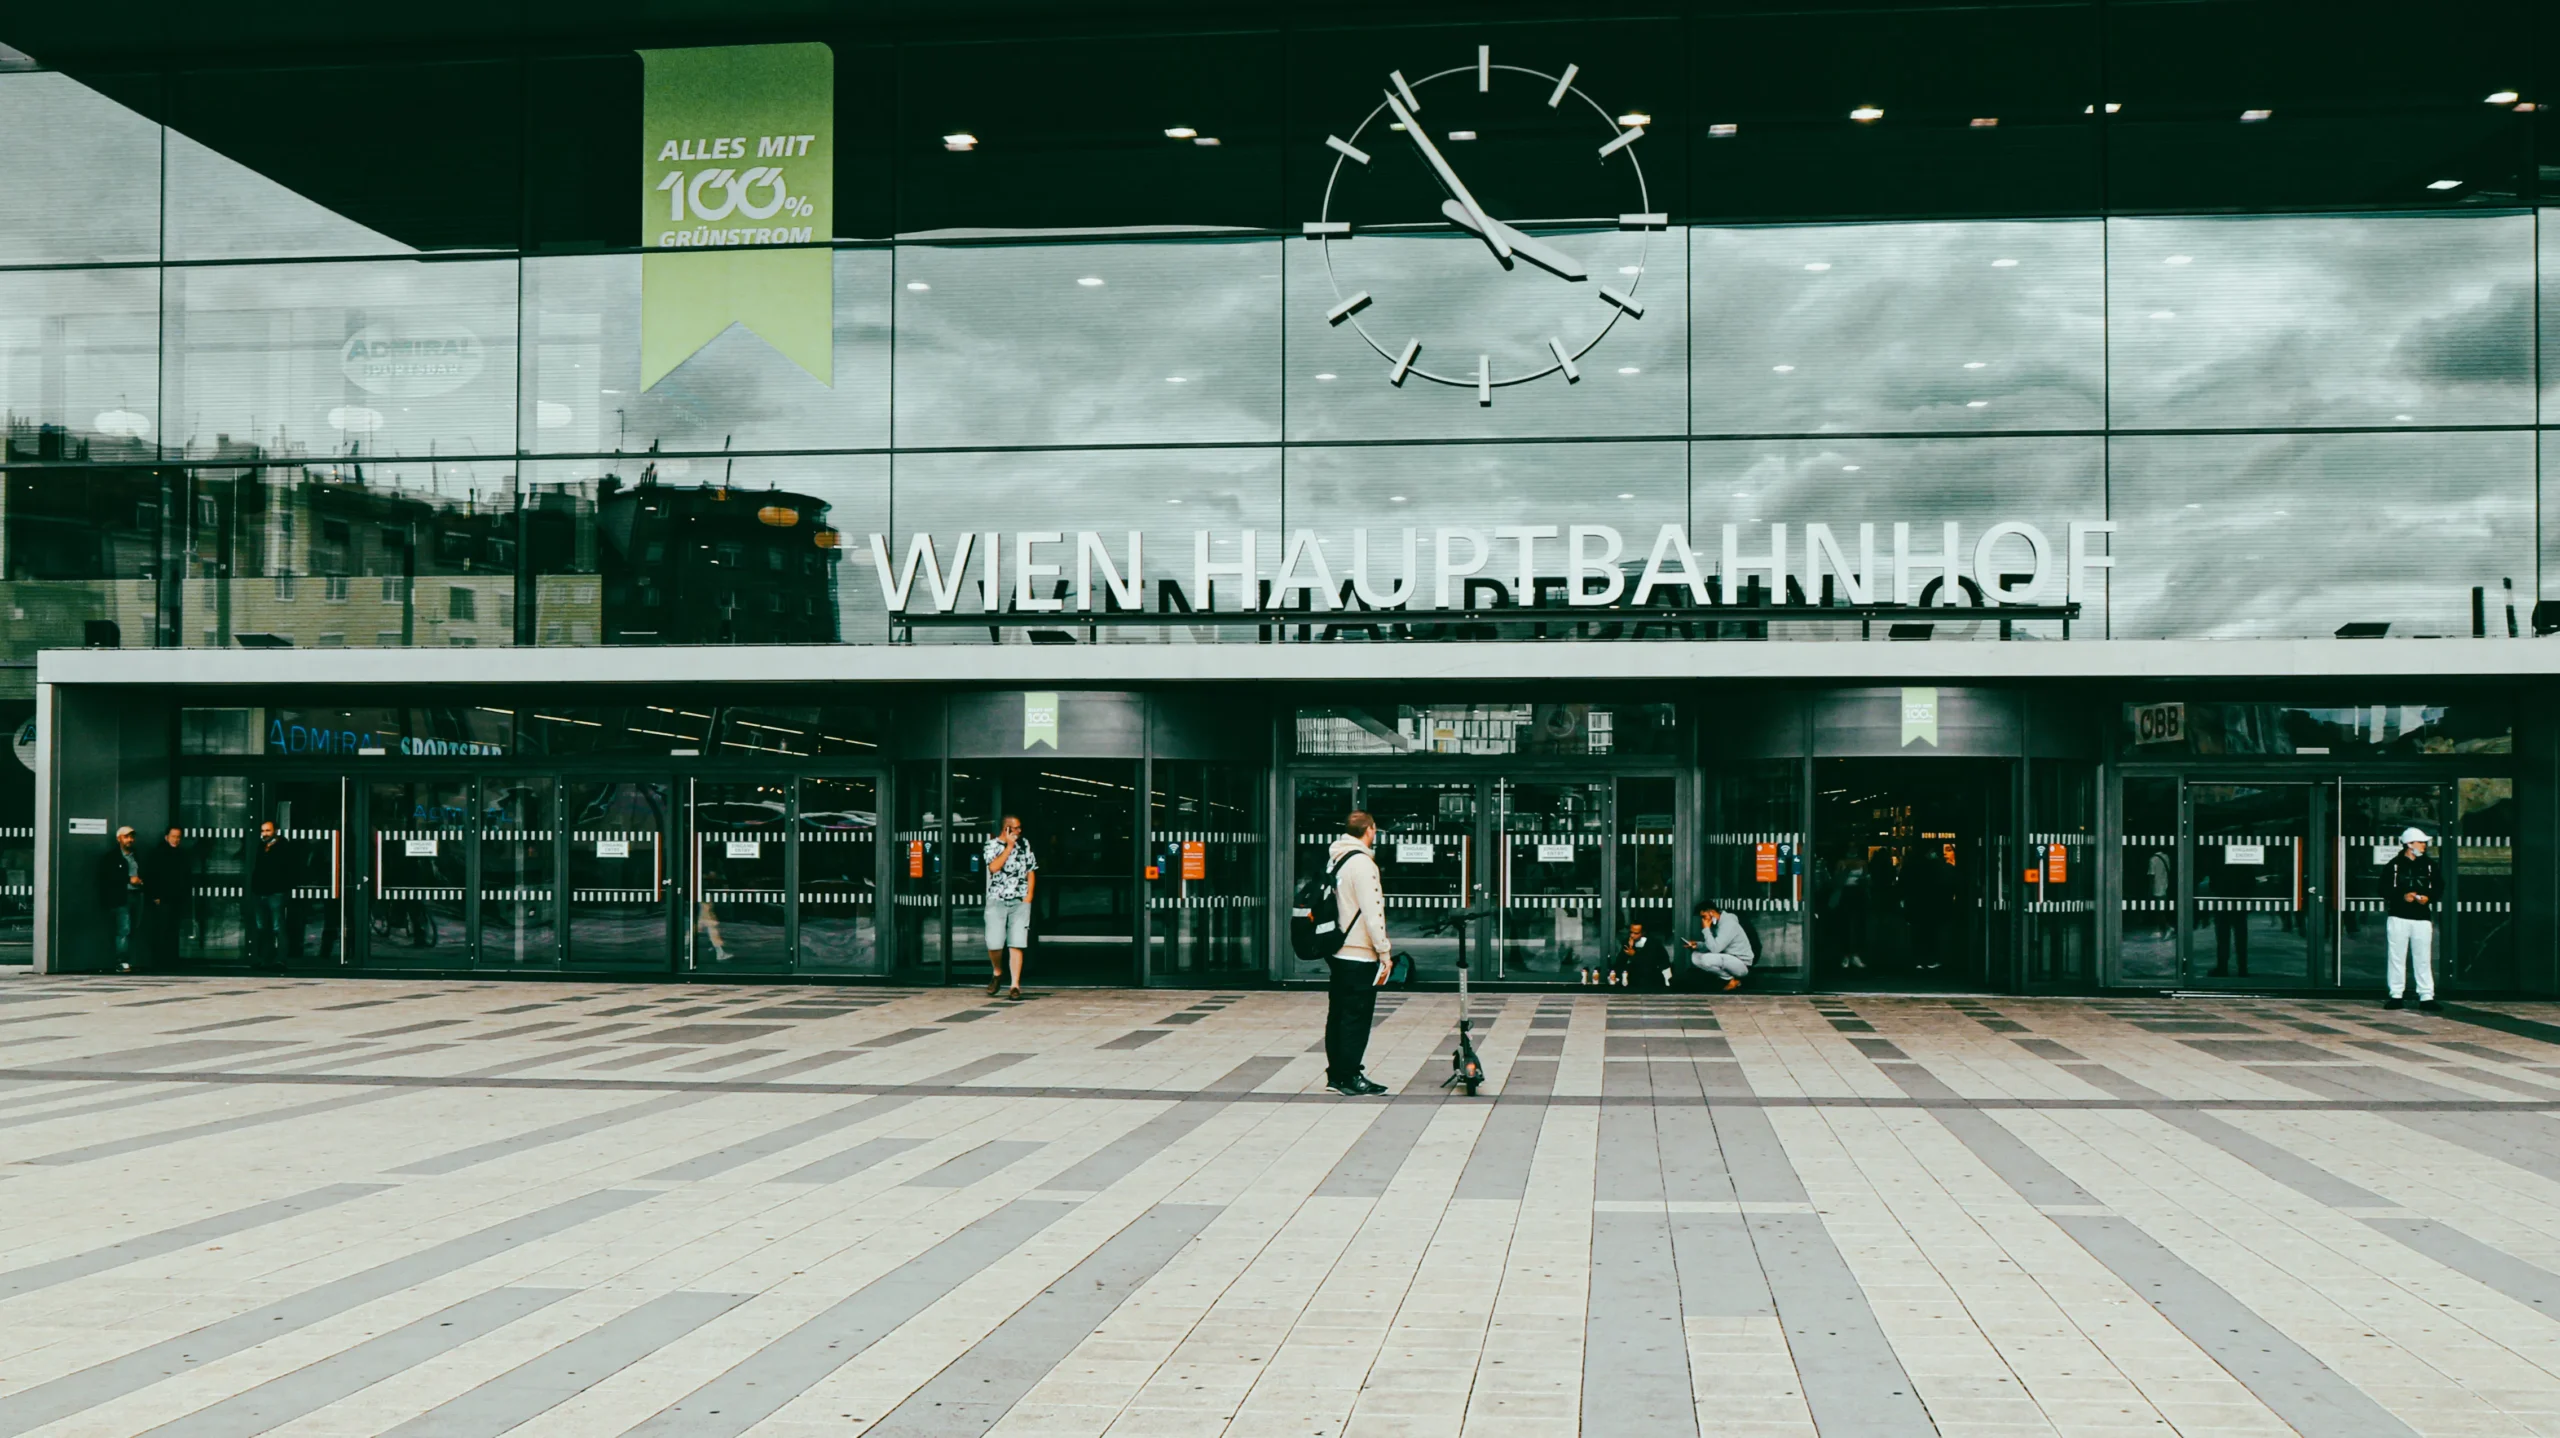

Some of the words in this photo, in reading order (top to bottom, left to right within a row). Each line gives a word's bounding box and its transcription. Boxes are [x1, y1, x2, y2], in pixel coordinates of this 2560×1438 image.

[657, 137, 747, 162] ALLES
[756, 134, 815, 159] MIT
[656, 166, 814, 222] 100%
[658, 226, 813, 248] GRÜNSTROM
[347, 337, 478, 361] ADMIRAL
[869, 531, 1143, 612] WIEN
[1195, 521, 2118, 610] HAUPTBAHNHOF
